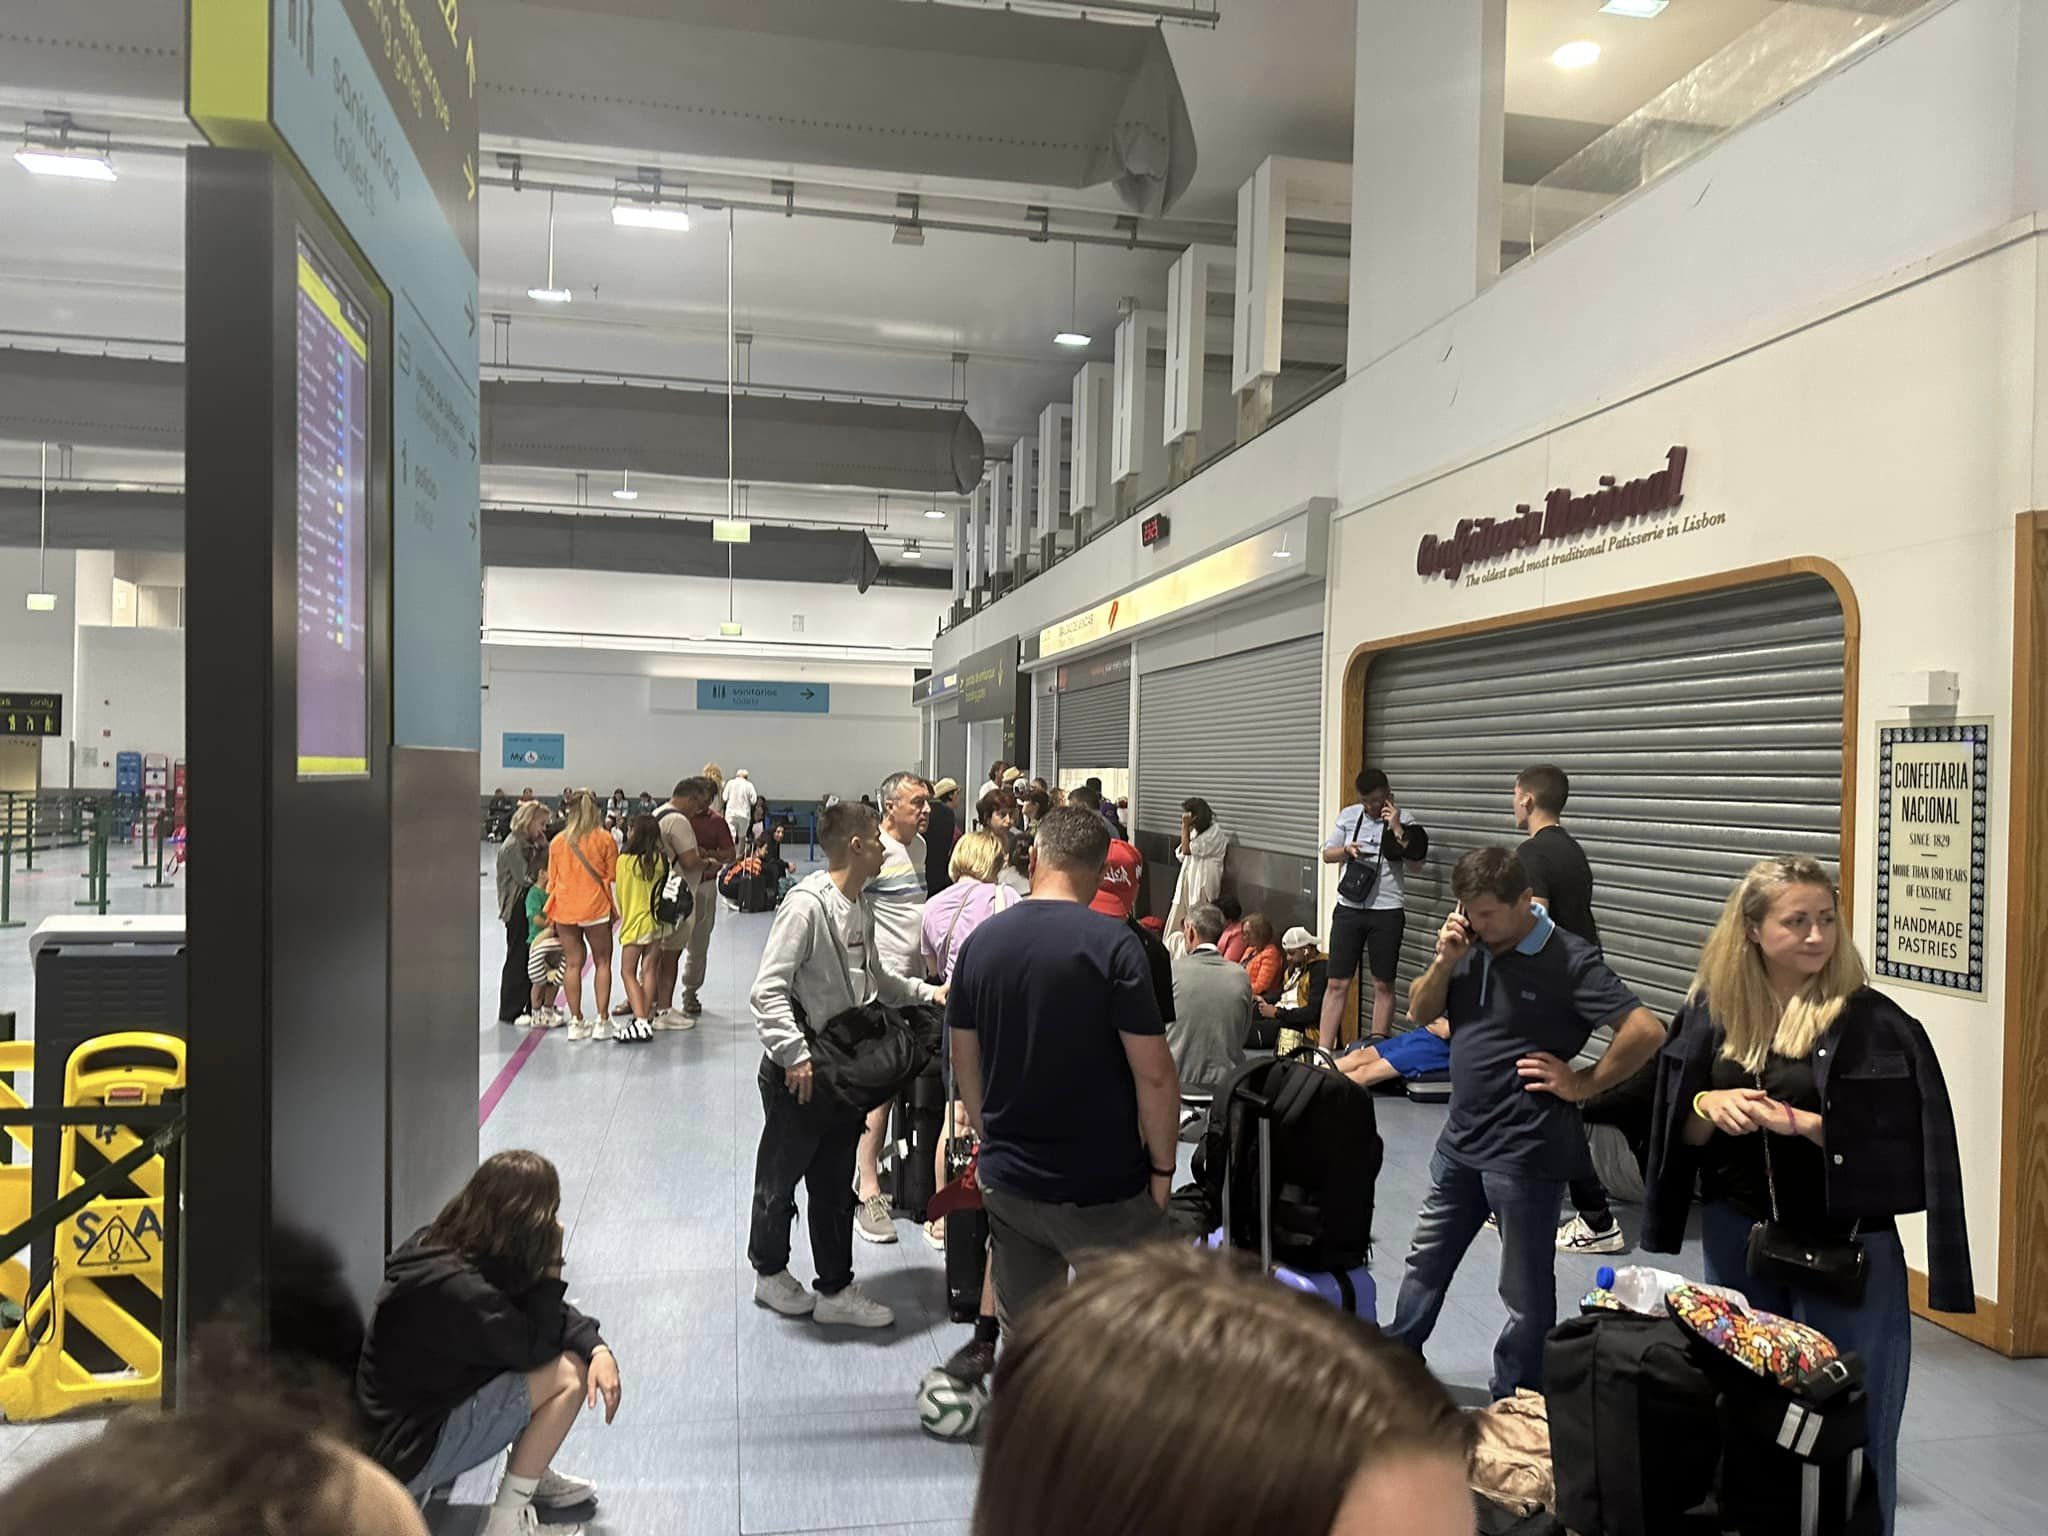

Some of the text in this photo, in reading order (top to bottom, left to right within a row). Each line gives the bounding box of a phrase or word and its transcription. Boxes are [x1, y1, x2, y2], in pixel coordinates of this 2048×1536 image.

[1465, 512, 1726, 587] The oldest and most traditional Patisserie in Lisbon
[1894, 762, 1968, 790] CONFEITARIA
[1901, 796, 1960, 825] NACIONAL
[1909, 832, 1950, 848] SINCE 1829
[1892, 863, 1968, 883] MORE THAN 180 YEARS
[1905, 884, 1953, 901] OF EXISTENCE
[1893, 914, 1963, 939] HANDMADE
[1898, 935, 1958, 959] PASTRIES
